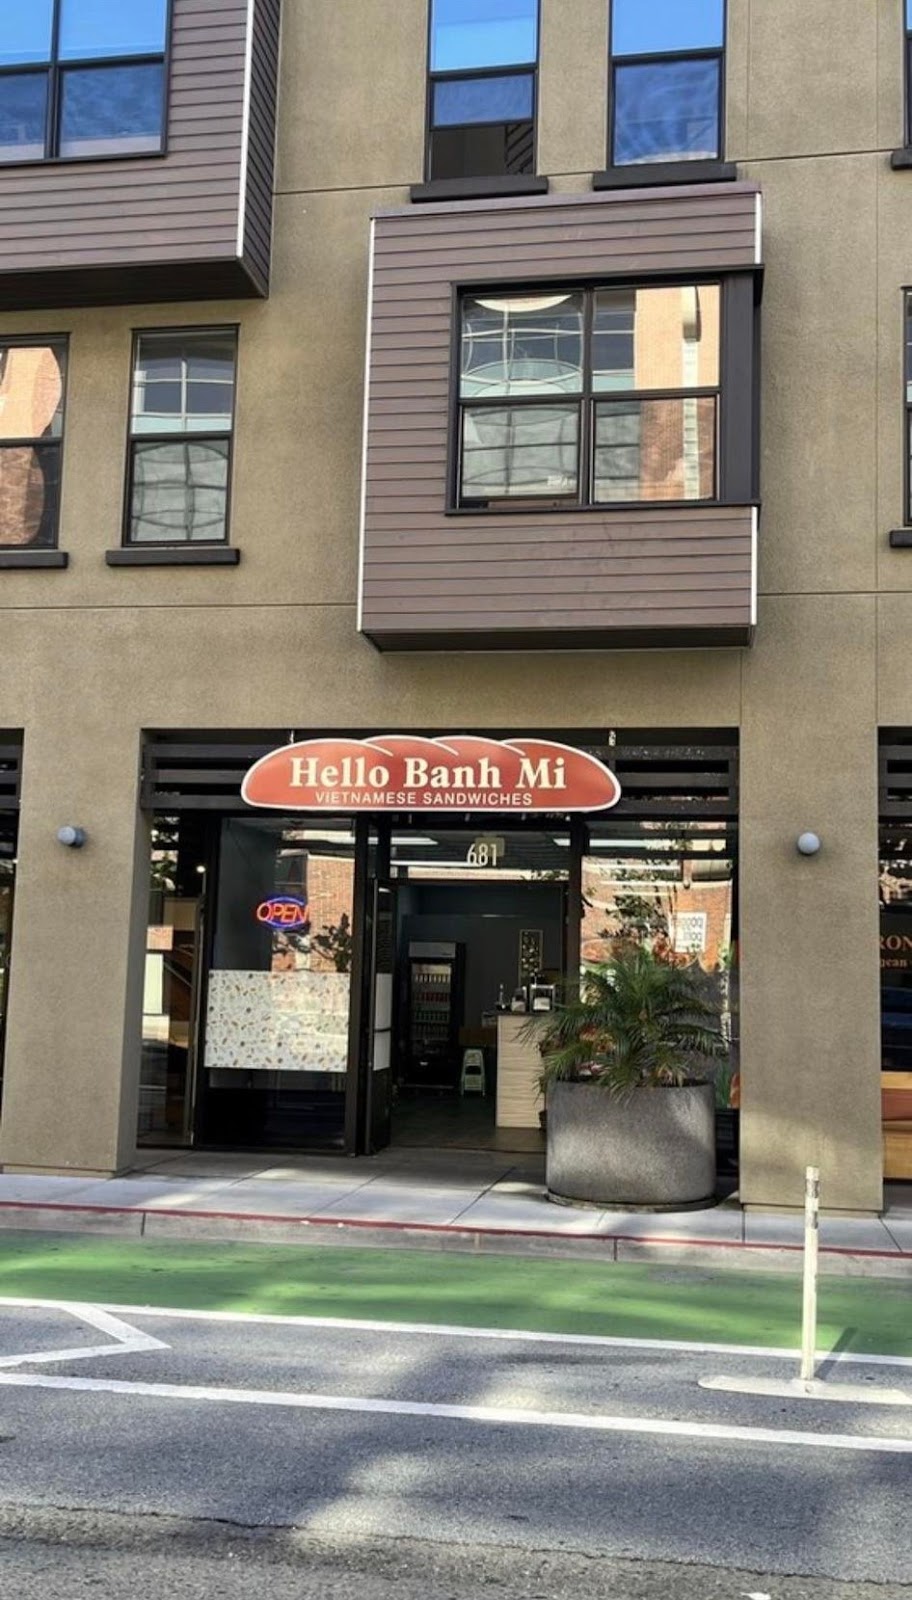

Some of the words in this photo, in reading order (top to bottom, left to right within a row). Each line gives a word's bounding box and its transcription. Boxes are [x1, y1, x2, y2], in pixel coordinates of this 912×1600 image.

[289, 756, 389, 788] Hello
[403, 756, 502, 788] Banh
[515, 757, 567, 789] Mi
[315, 791, 417, 804] VIETNAMESE
[423, 792, 532, 805] SANDWICHES
[467, 843, 497, 867] 681
[257, 902, 310, 923] OPEN
